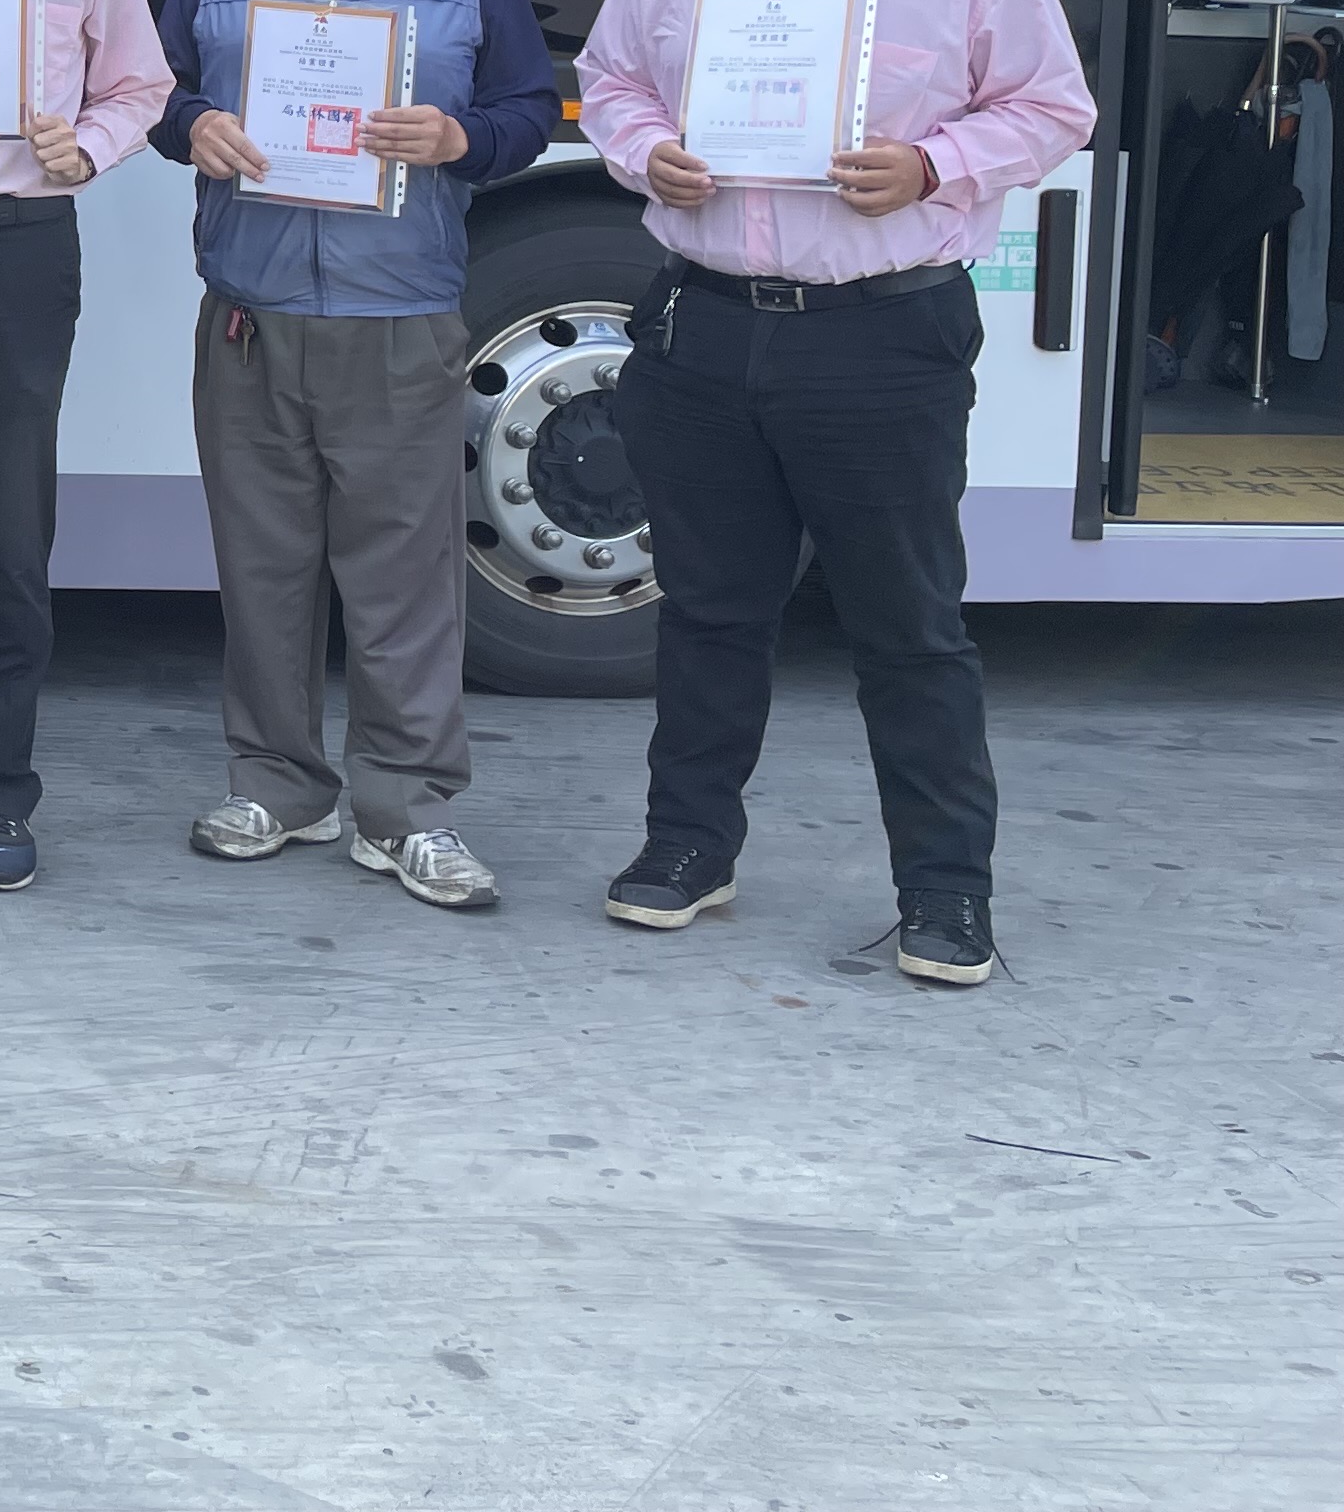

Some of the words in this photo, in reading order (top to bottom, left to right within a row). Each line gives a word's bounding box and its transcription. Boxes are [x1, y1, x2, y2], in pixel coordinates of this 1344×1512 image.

[281, 104, 356, 123] 局長林國華
